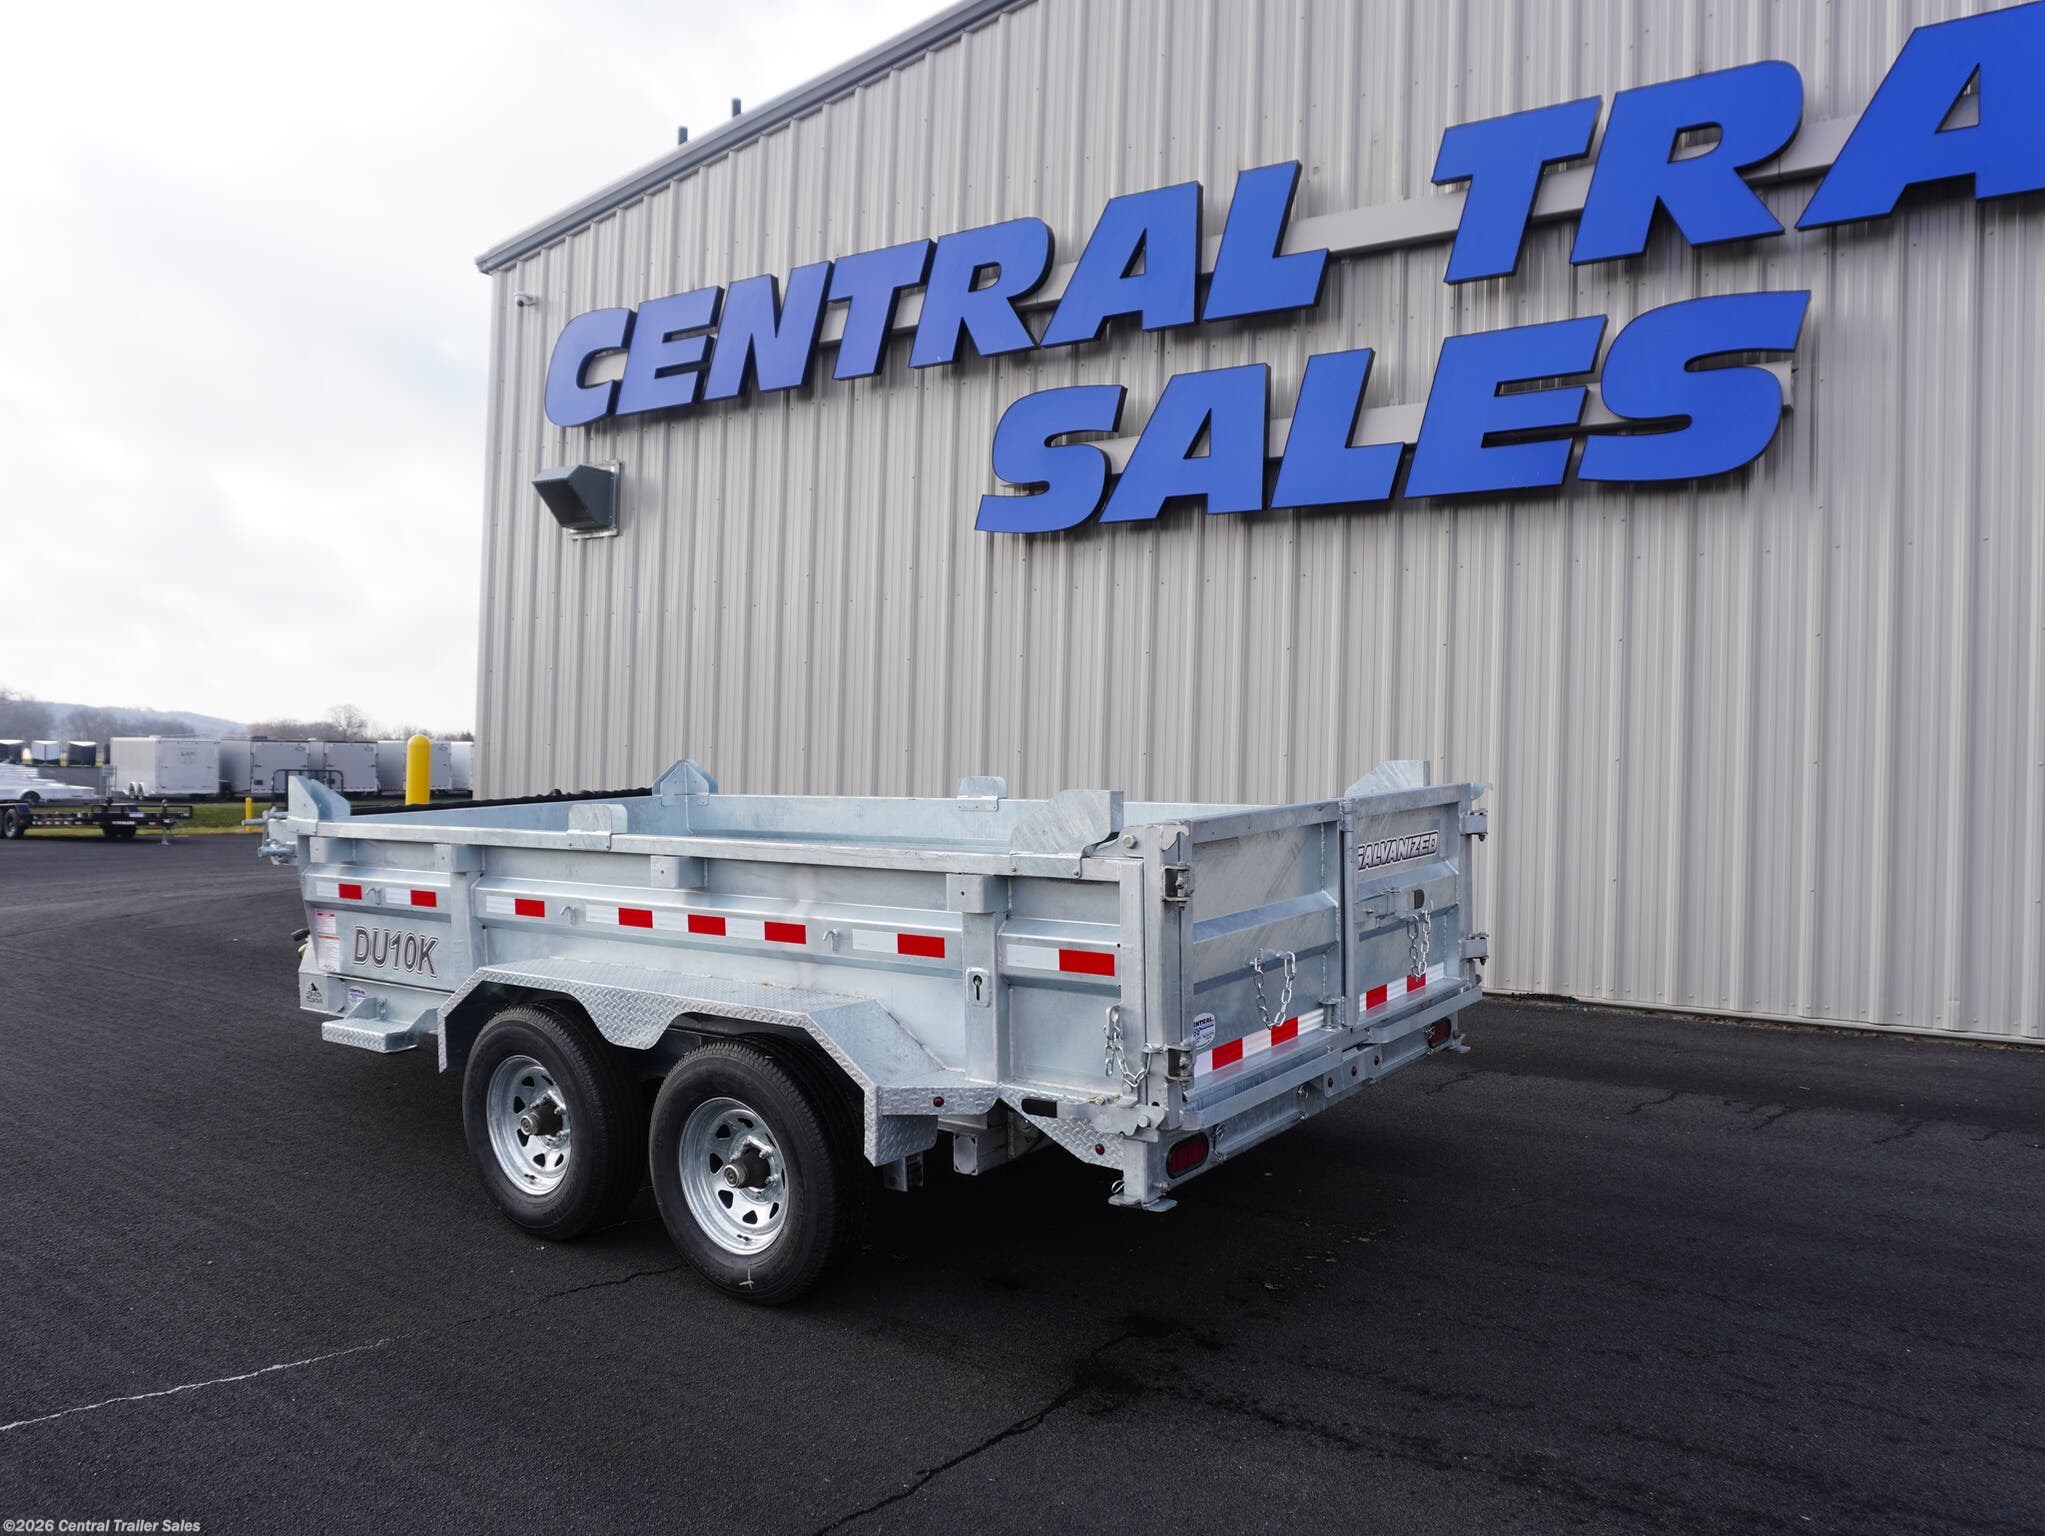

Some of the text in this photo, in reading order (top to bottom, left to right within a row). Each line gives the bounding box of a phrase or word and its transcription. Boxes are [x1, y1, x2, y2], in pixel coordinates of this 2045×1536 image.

[544, 0, 2045, 428] CENTRAL TRA
[974, 290, 1811, 534] SALES
[352, 925, 439, 978] DU10K
